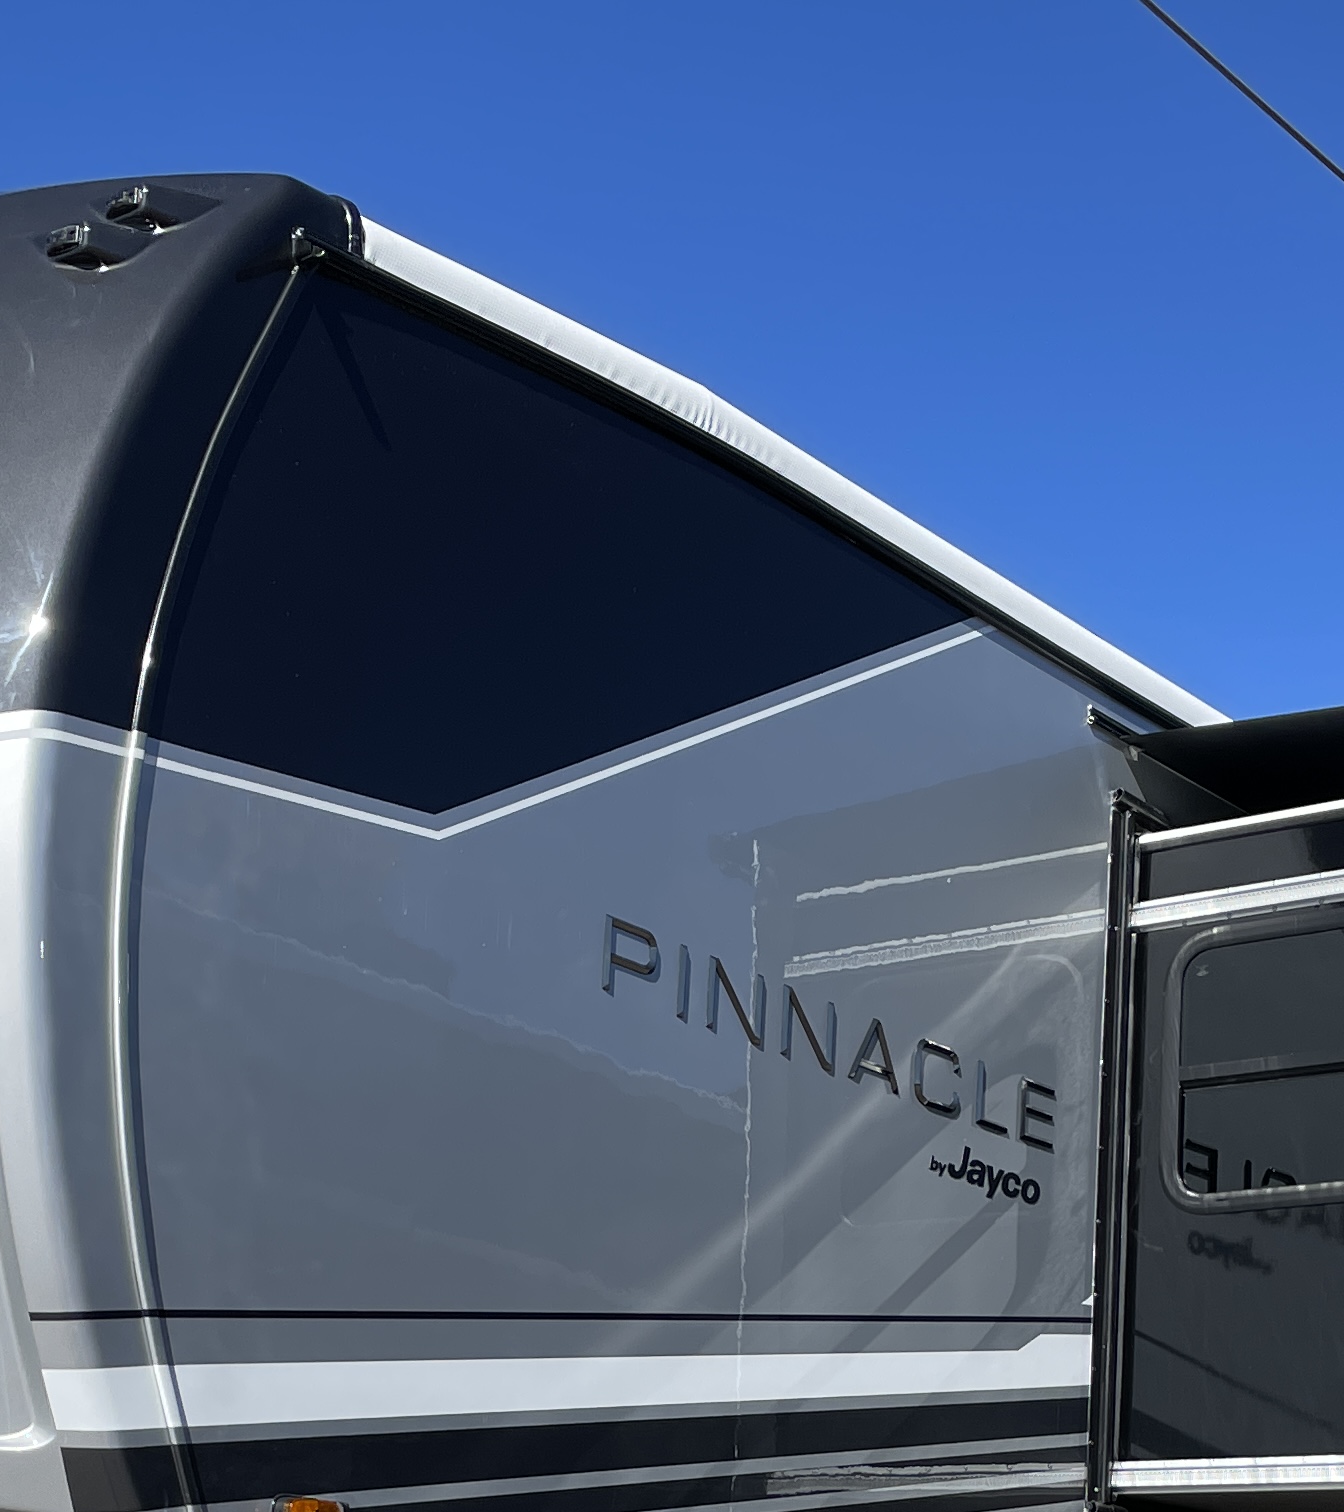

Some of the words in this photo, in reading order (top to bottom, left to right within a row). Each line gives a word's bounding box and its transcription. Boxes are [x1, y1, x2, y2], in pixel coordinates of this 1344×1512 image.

[601, 914, 1056, 1152] PINNACLE
[929, 1155, 946, 1177] by
[947, 1146, 1041, 1205] Jayco
